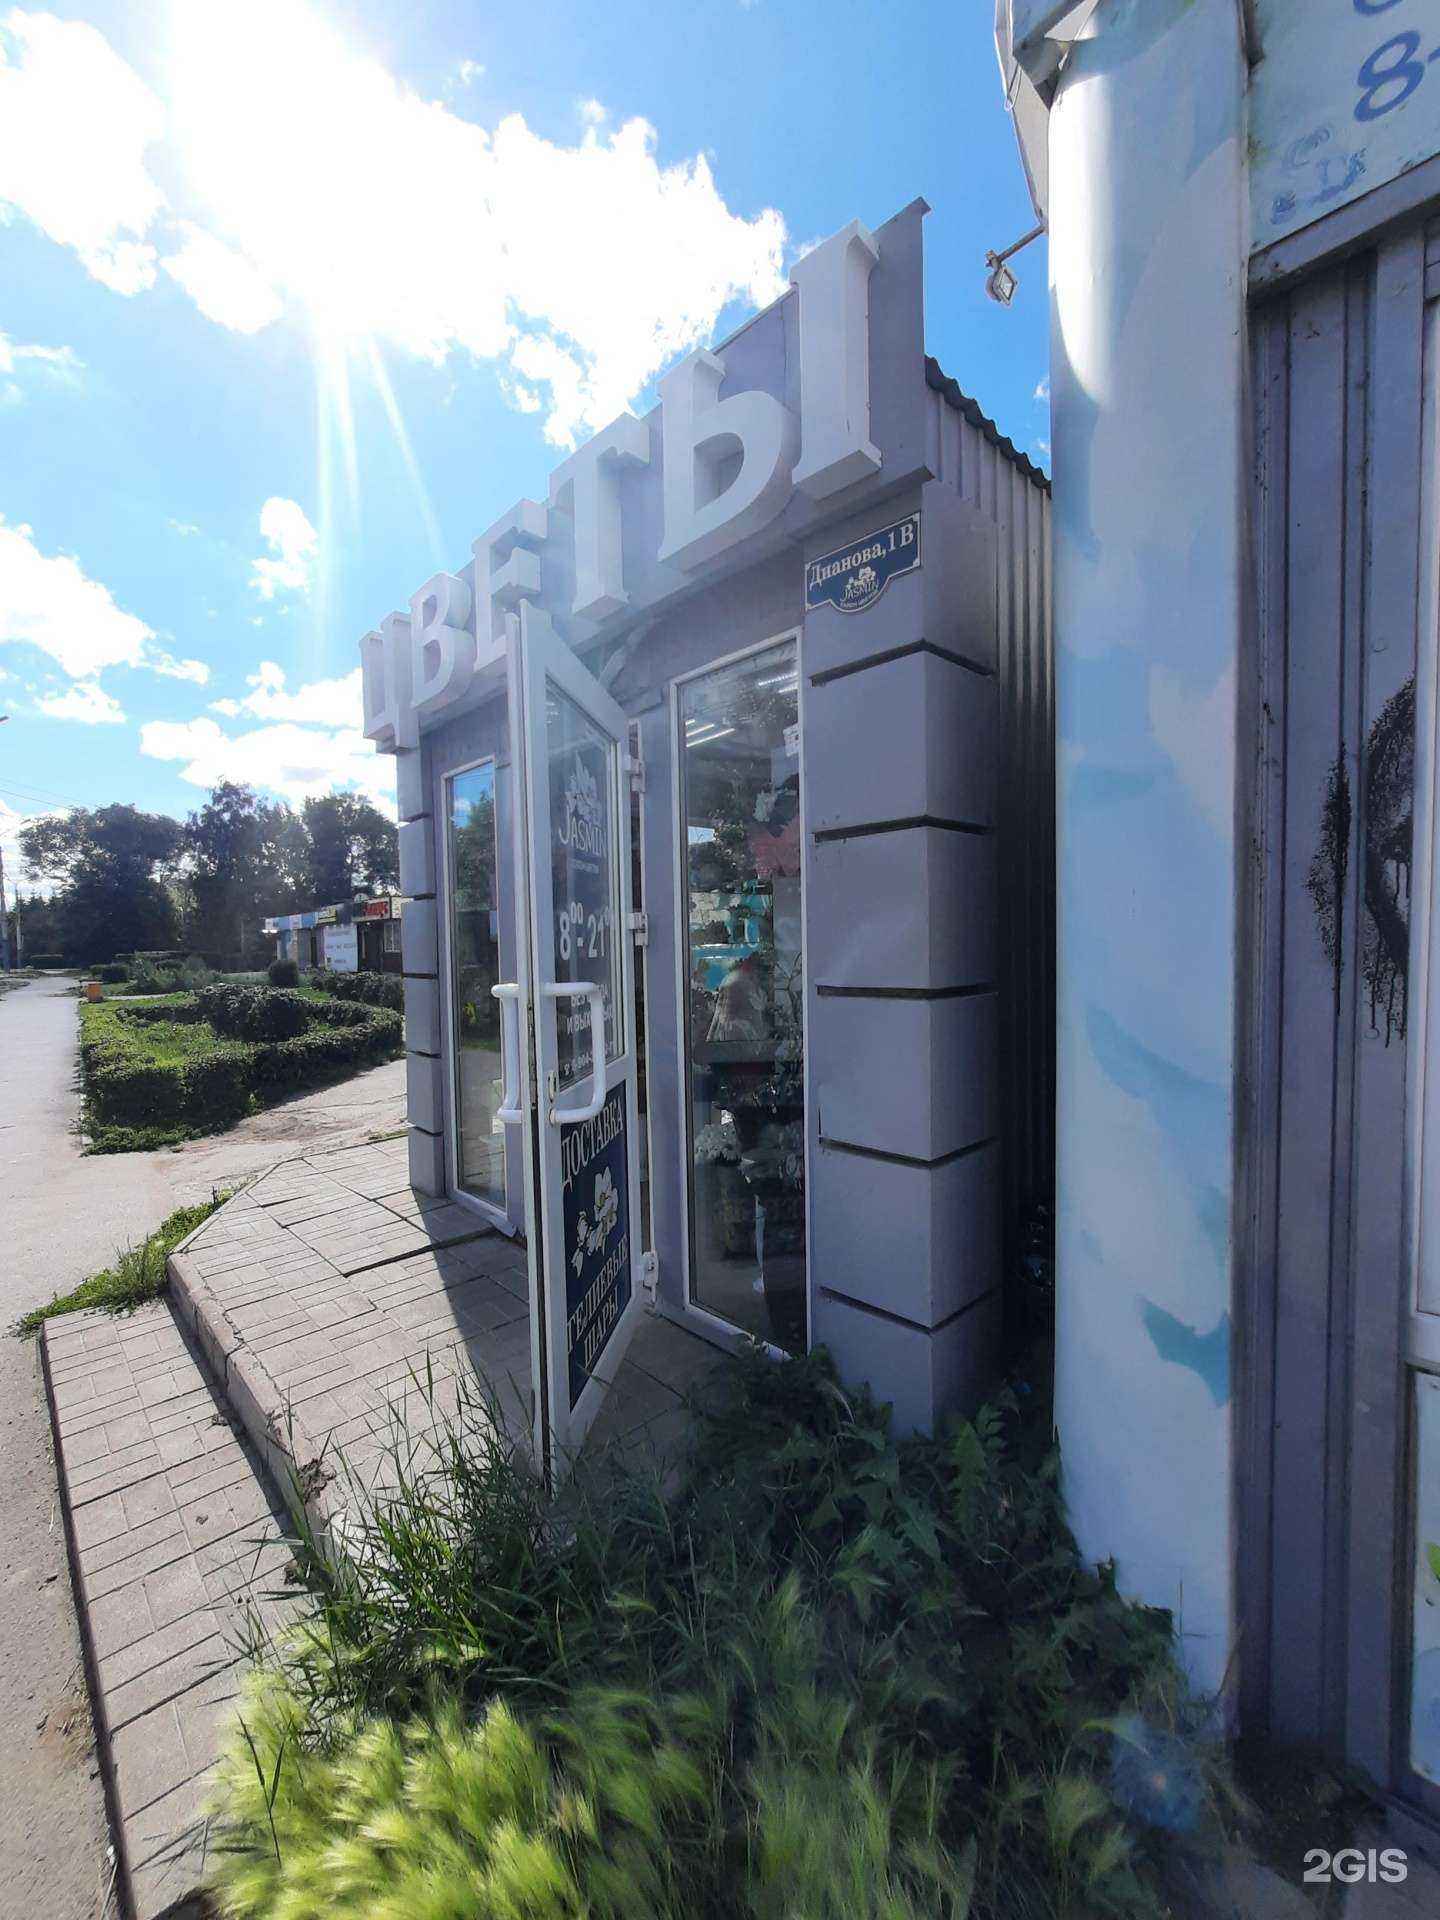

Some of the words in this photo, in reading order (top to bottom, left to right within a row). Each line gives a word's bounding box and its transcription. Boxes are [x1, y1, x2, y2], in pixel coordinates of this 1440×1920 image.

[358, 218, 881, 755] ЦВЕТЫ
[559, 804, 608, 860] JASMIN
[561, 1095, 624, 1192] ДОСТАВКА
[566, 1232, 629, 1353] ГЕЛИЕВЫЕ
[583, 1283, 619, 1371] ШАРЫ
